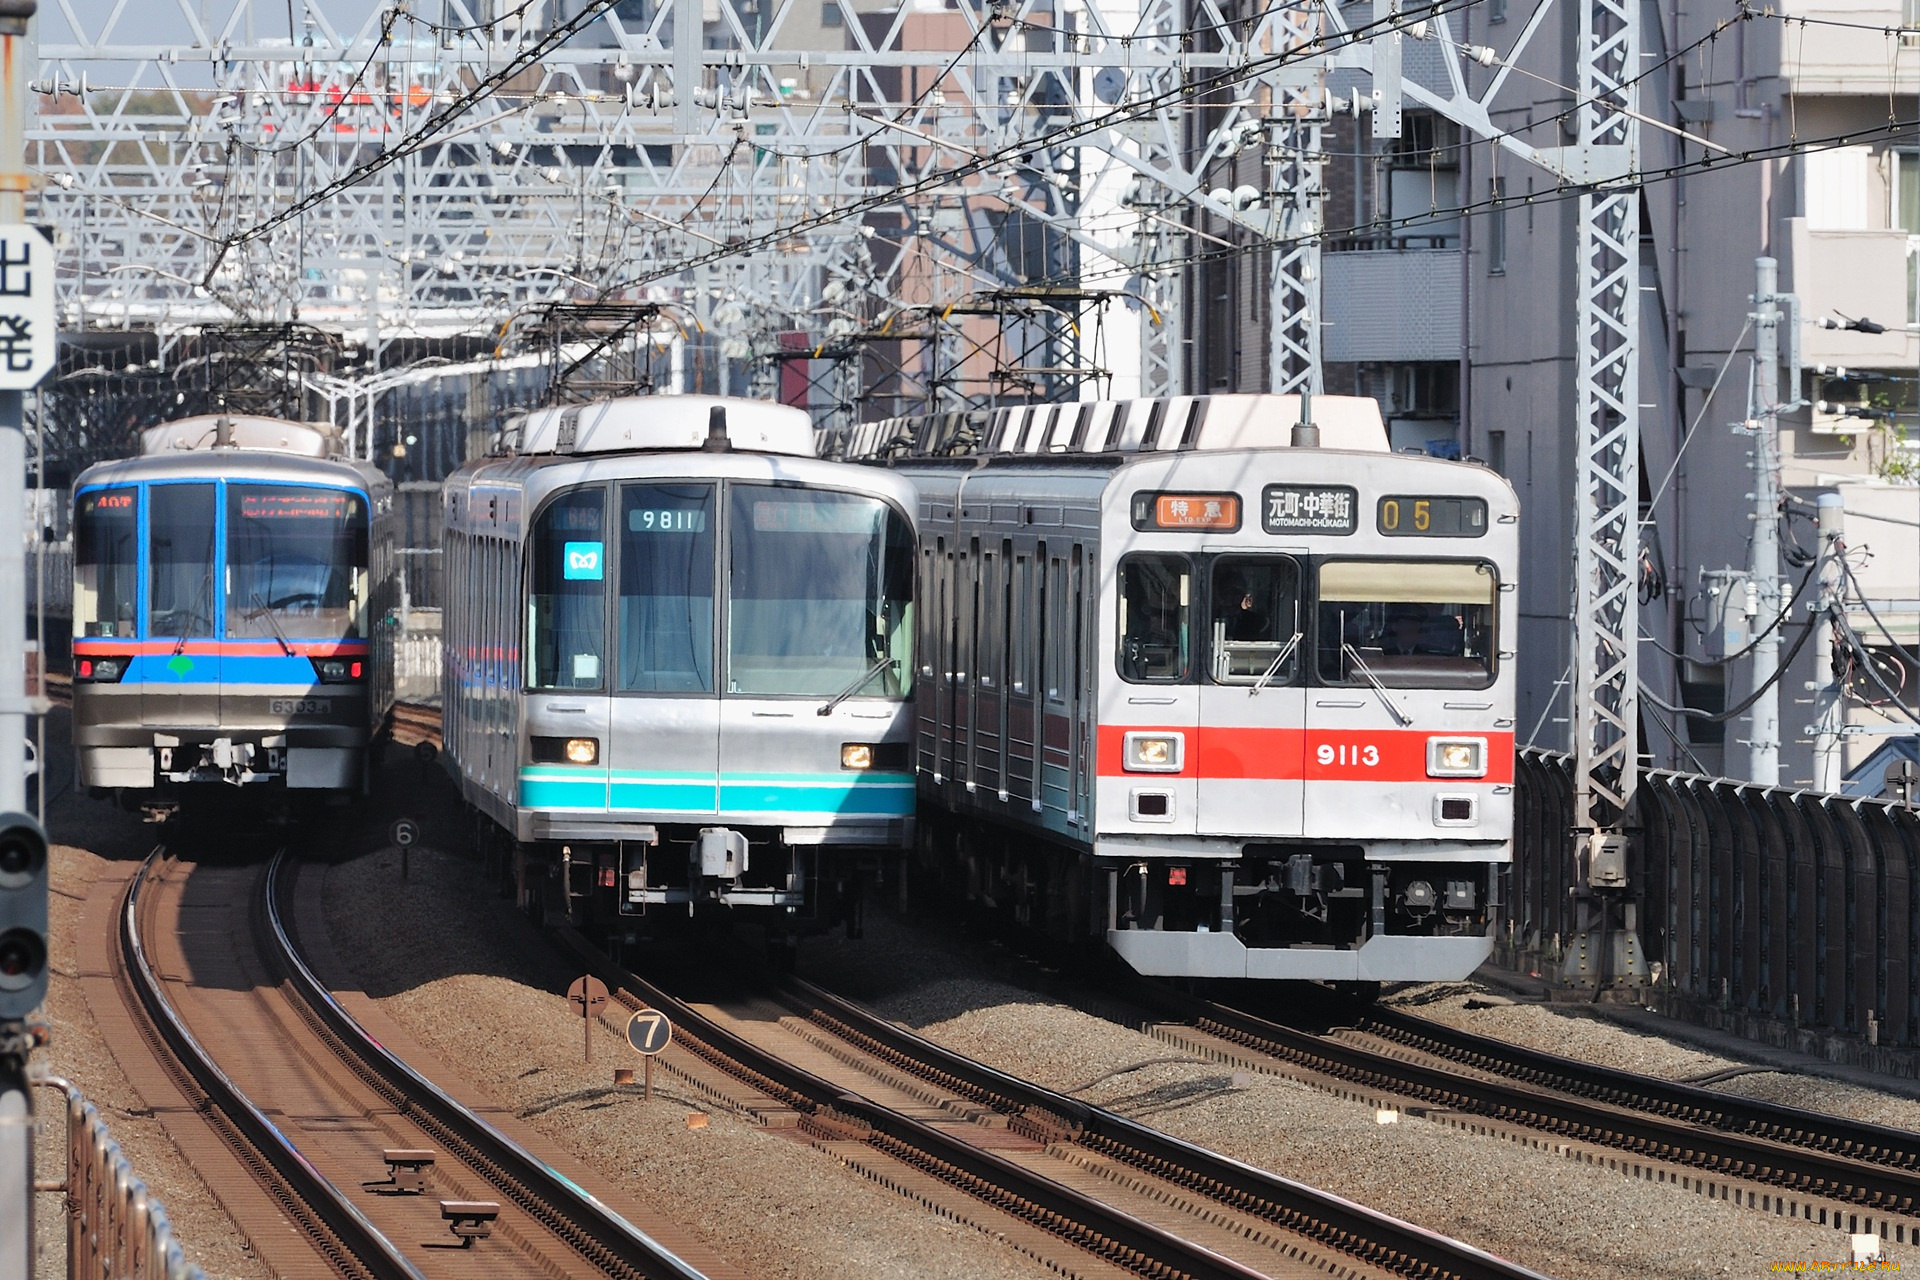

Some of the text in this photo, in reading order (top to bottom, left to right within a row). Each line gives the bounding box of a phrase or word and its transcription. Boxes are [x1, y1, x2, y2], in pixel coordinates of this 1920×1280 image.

[1171, 500, 1222, 518] 特急
[643, 511, 692, 529] 9811
[1316, 744, 1380, 767] 9113
[396, 823, 412, 844] 6
[637, 1015, 661, 1048] 7
